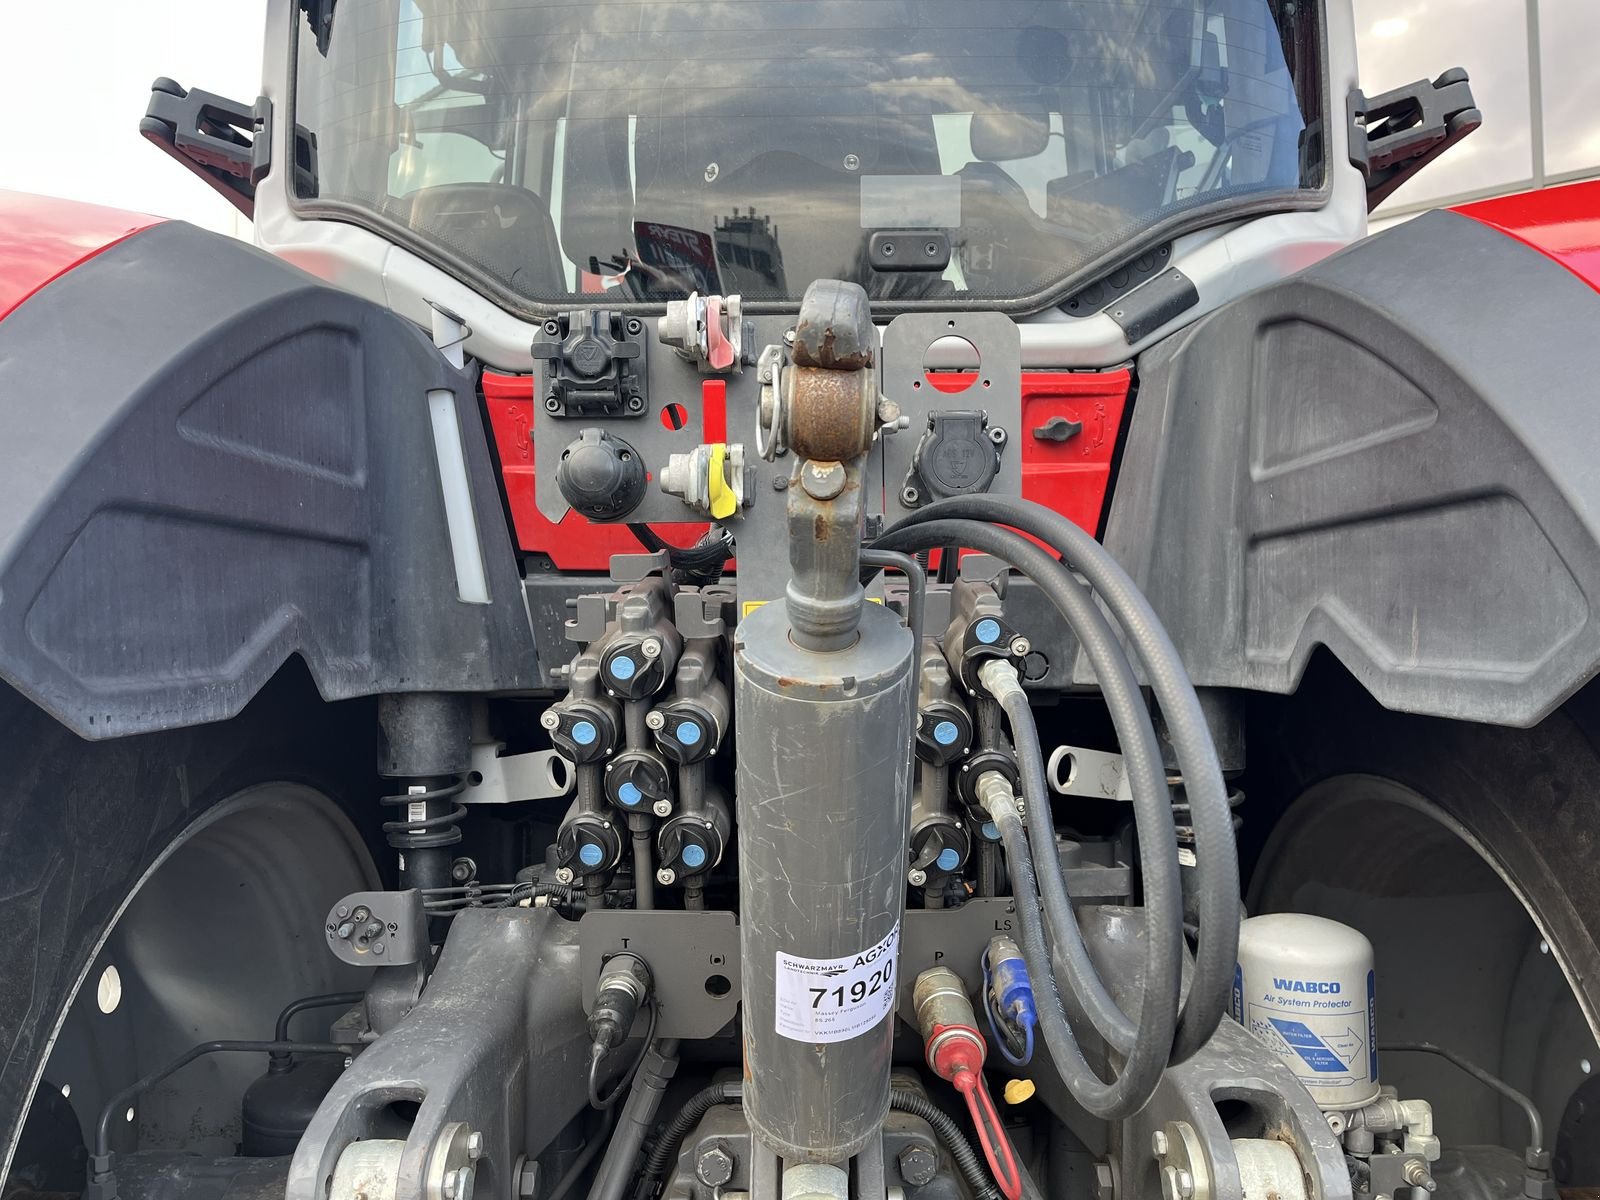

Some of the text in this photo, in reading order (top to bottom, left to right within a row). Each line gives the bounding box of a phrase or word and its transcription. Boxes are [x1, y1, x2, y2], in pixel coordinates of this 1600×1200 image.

[995, 920, 1012, 931] LS
[621, 938, 630, 949] T
[935, 951, 944, 962] P
[783, 959, 844, 971] SCHWARZMAYR
[809, 959, 892, 1008] 71920
[1273, 978, 1340, 994] WABCO
[1264, 994, 1352, 1008] Air System Protector
